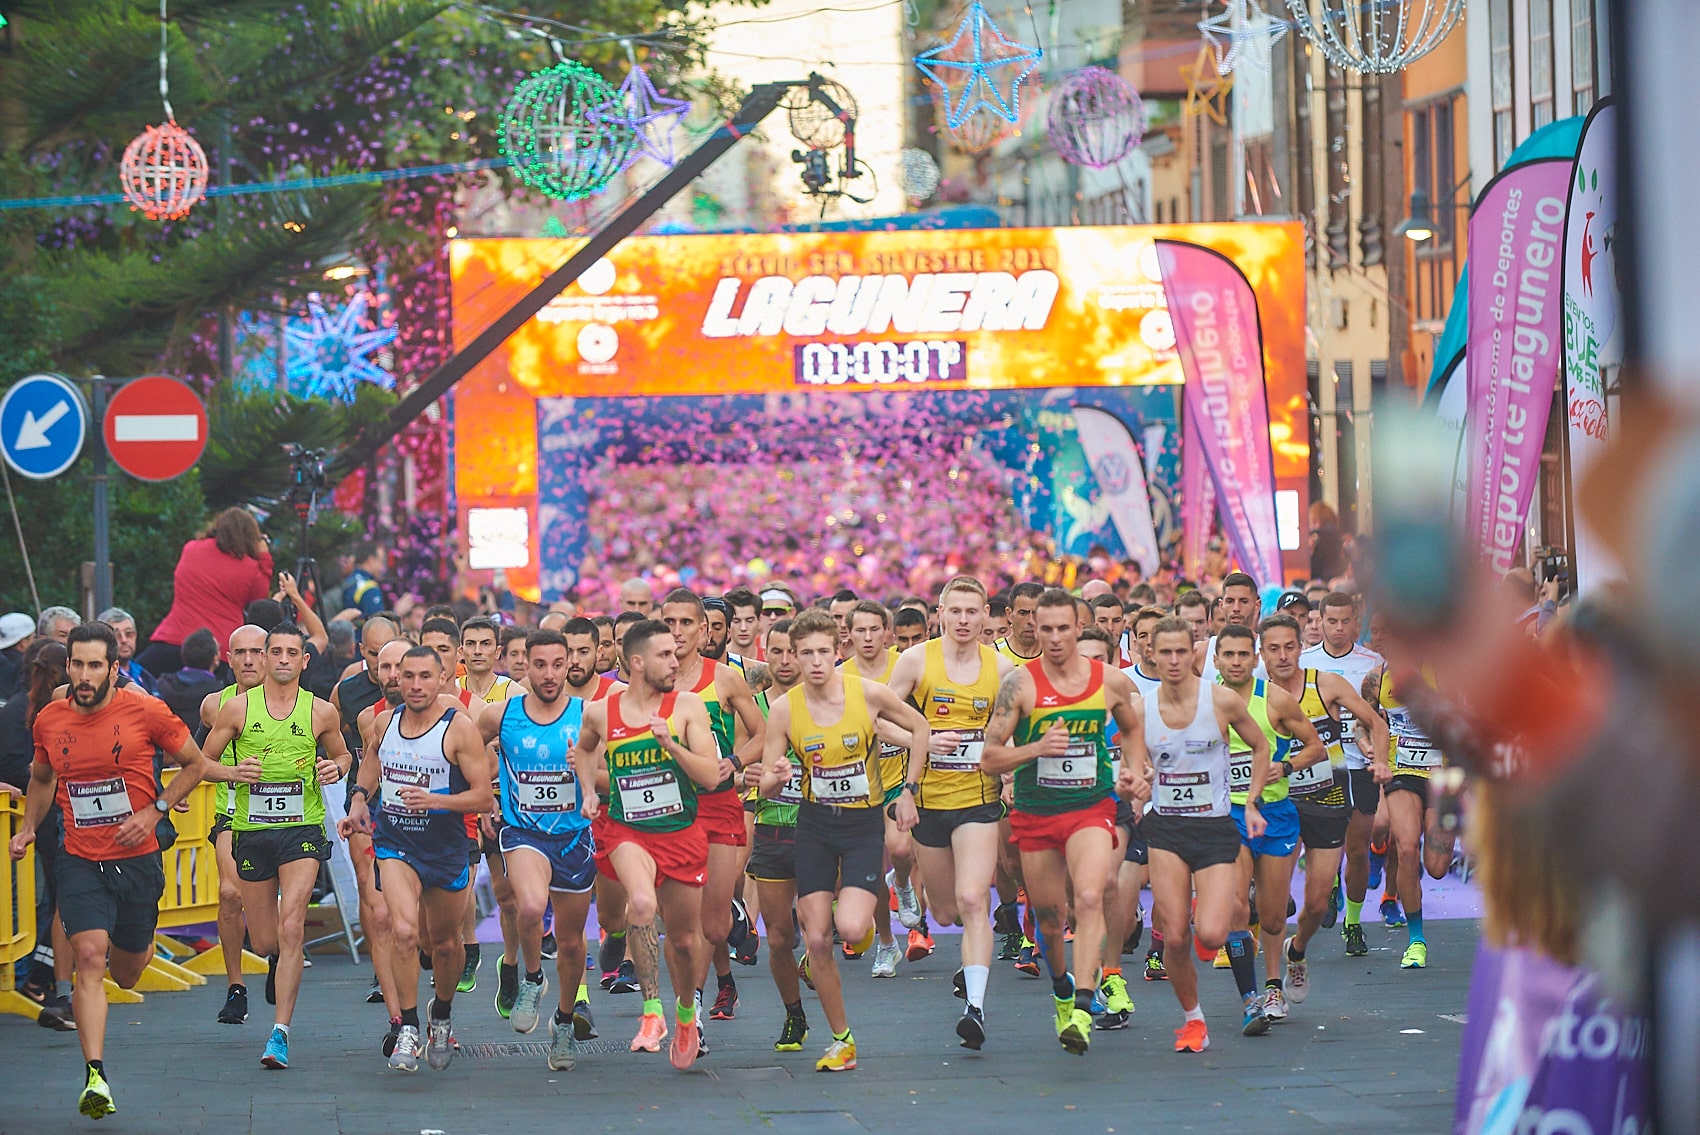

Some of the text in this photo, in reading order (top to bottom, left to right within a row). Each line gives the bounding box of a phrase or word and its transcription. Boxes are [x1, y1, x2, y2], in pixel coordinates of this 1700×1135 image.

[1493, 187, 1523, 289] Deportes
[868, 250, 986, 275] SILVESTRE
[701, 269, 1060, 338] LAGUNERA
[1490, 295, 1505, 323] de
[1565, 292, 1595, 334] EVENTOS
[1485, 196, 1566, 576] deporte lagunero
[615, 747, 672, 768] BIKILA
[1408, 750, 1428, 762] 77
[1062, 760, 1073, 773] 6
[1230, 766, 1252, 780] 90
[528, 775, 563, 783] LAGUNERA
[1295, 767, 1314, 781] 31
[77, 784, 112, 795] LAGUNERA
[259, 785, 293, 794] LAGUNERA
[629, 776, 663, 789] LAGUNERA
[785, 778, 802, 792] 43
[829, 779, 851, 793] 18
[534, 786, 558, 800] 36
[643, 789, 655, 804] 8
[1172, 787, 1195, 801] 24
[93, 797, 103, 811] 1
[264, 797, 287, 811] 15
[398, 818, 431, 826] ADELEY
